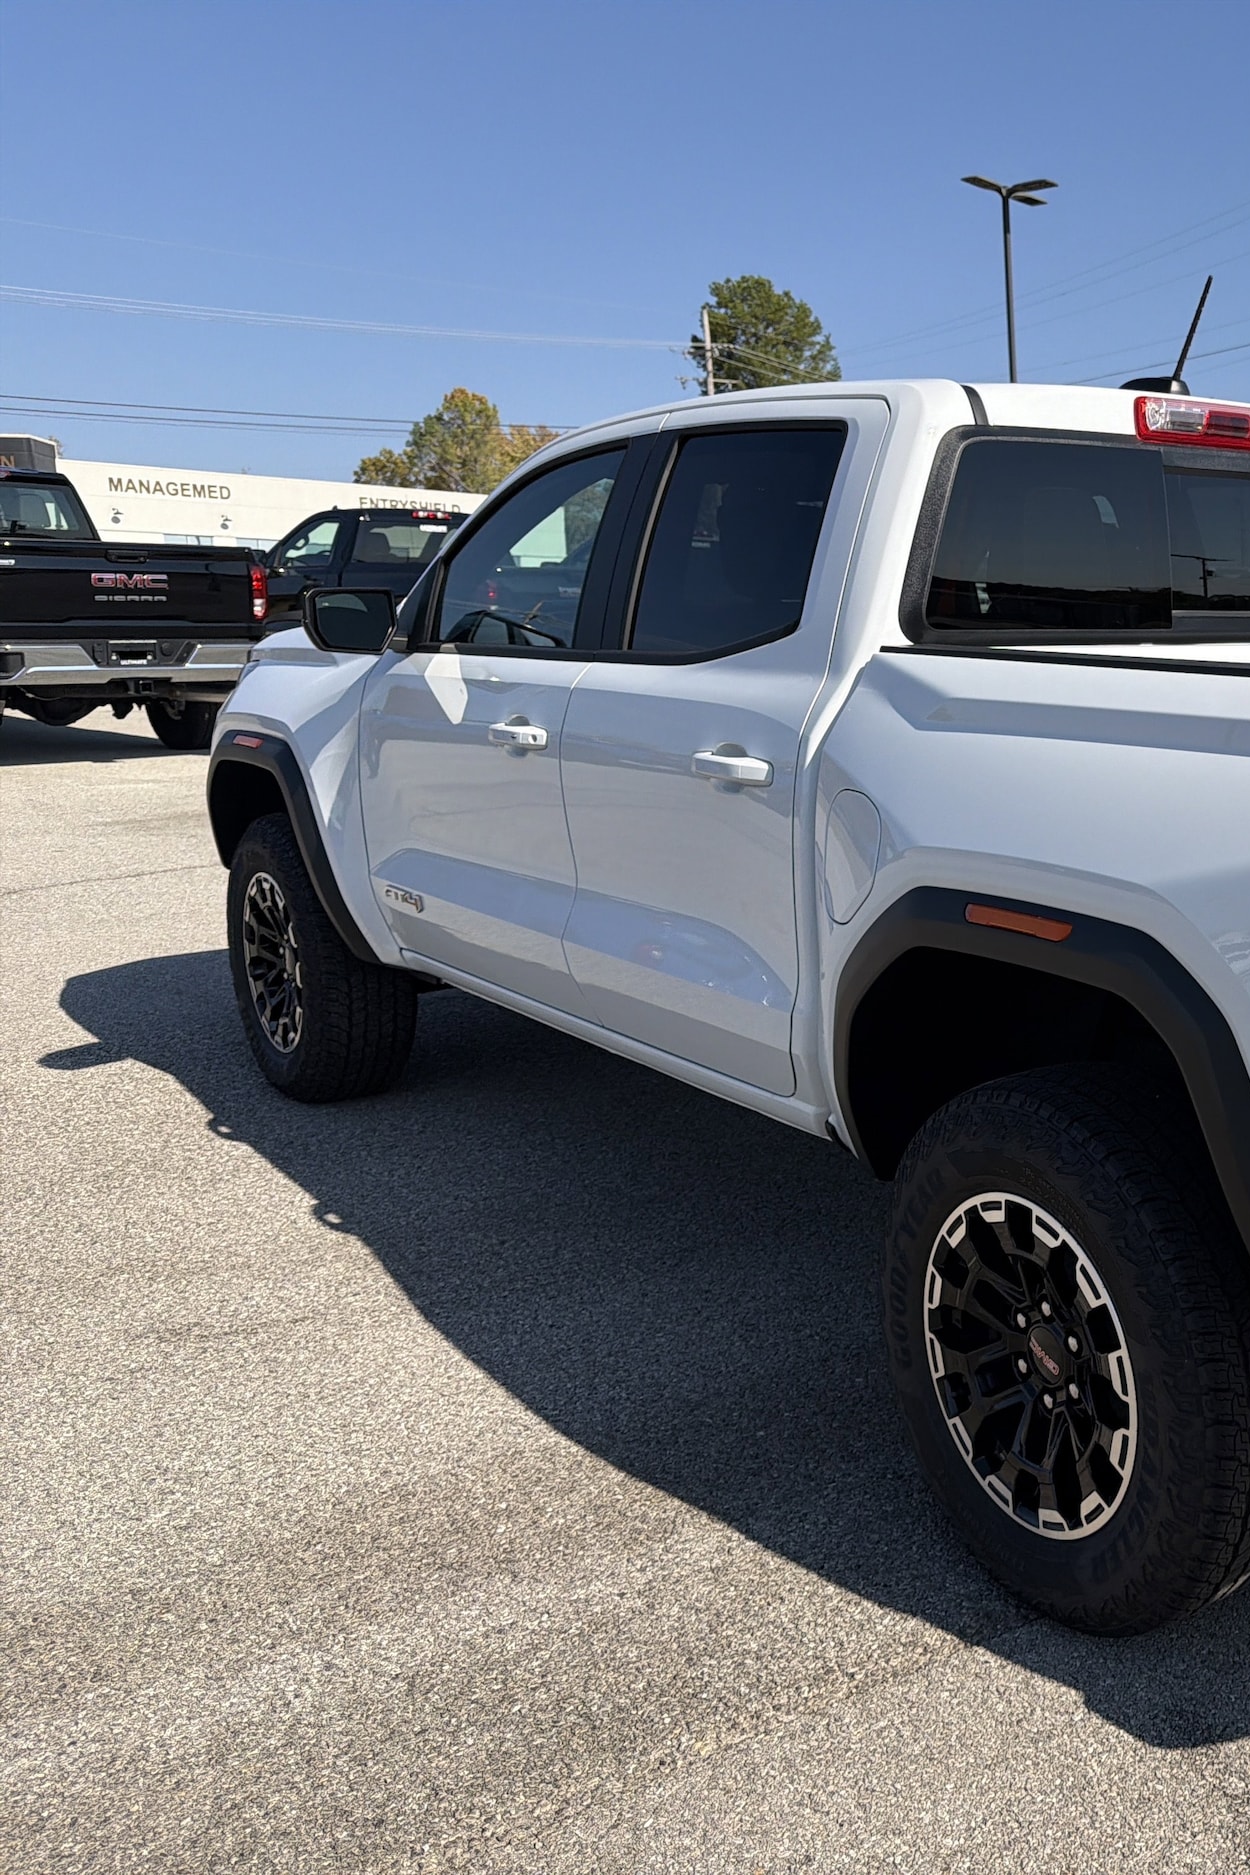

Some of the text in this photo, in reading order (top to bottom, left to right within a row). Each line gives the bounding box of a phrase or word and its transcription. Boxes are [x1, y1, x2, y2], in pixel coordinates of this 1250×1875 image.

[108, 477, 231, 500] MANAGEMED
[91, 573, 169, 589] GMC
[1029, 1335, 1060, 1376] GMC
